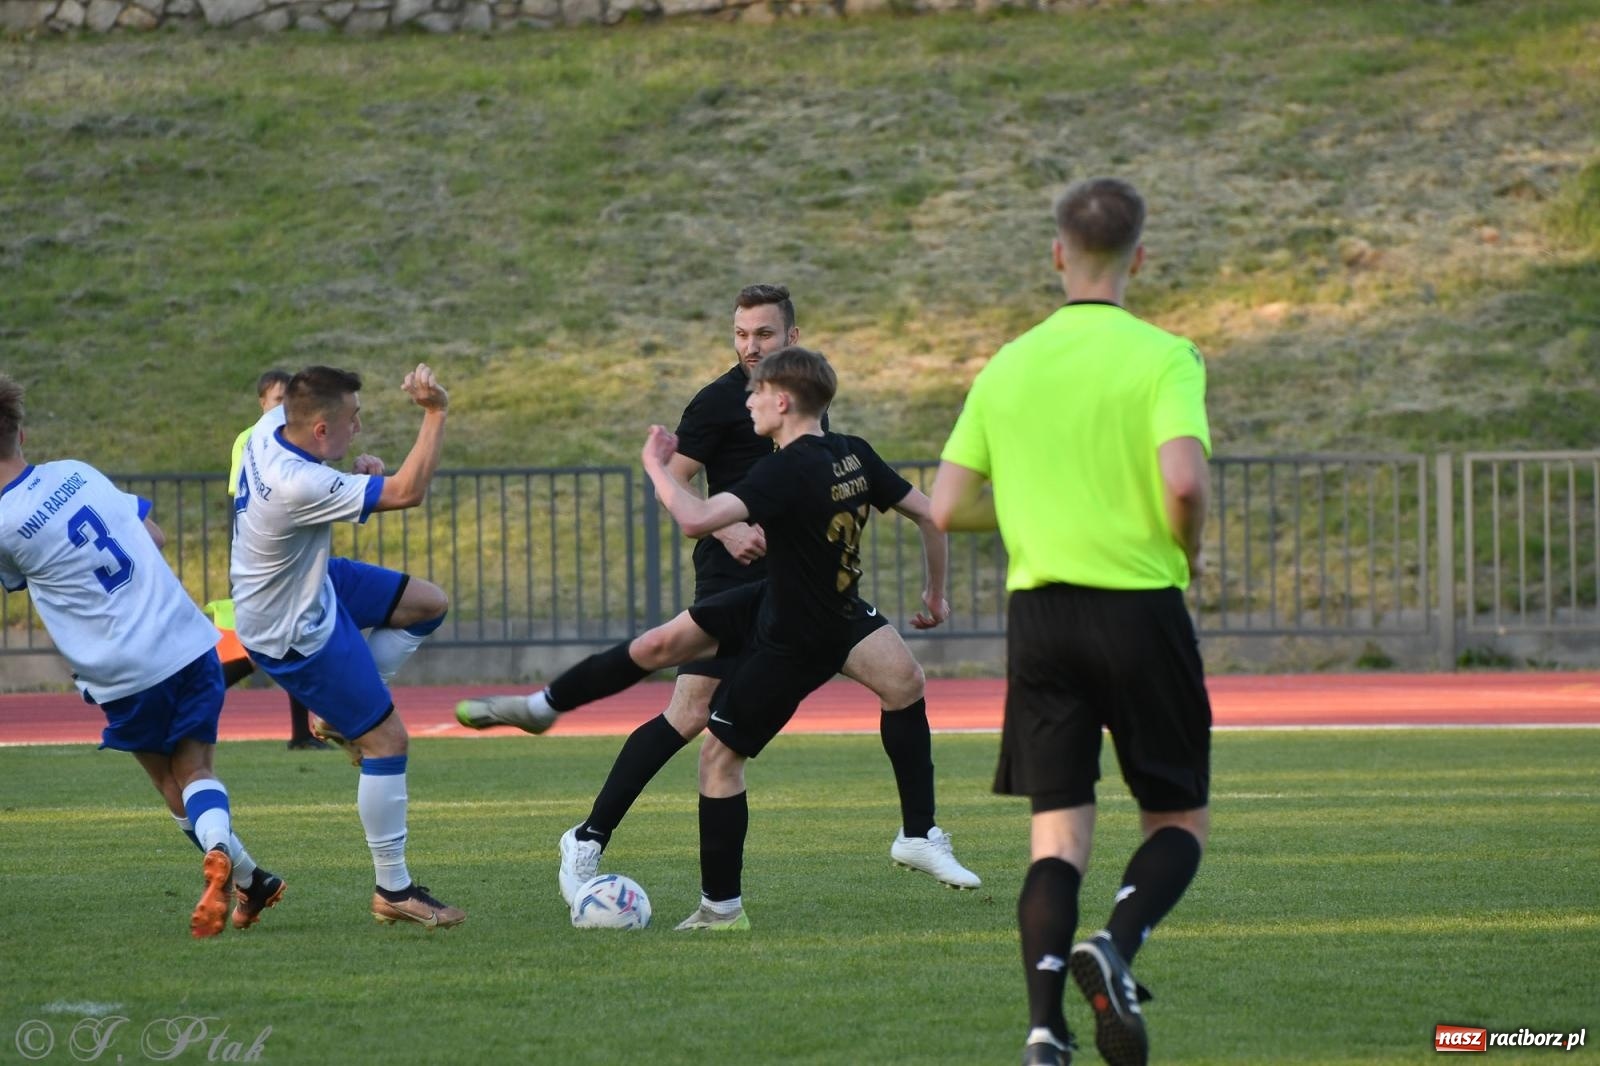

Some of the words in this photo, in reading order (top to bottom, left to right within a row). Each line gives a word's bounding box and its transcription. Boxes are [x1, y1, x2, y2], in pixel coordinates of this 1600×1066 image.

[17, 509, 50, 540] UNIA
[47, 472, 88, 516] RACIBÓRZ
[67, 504, 135, 595] 3
